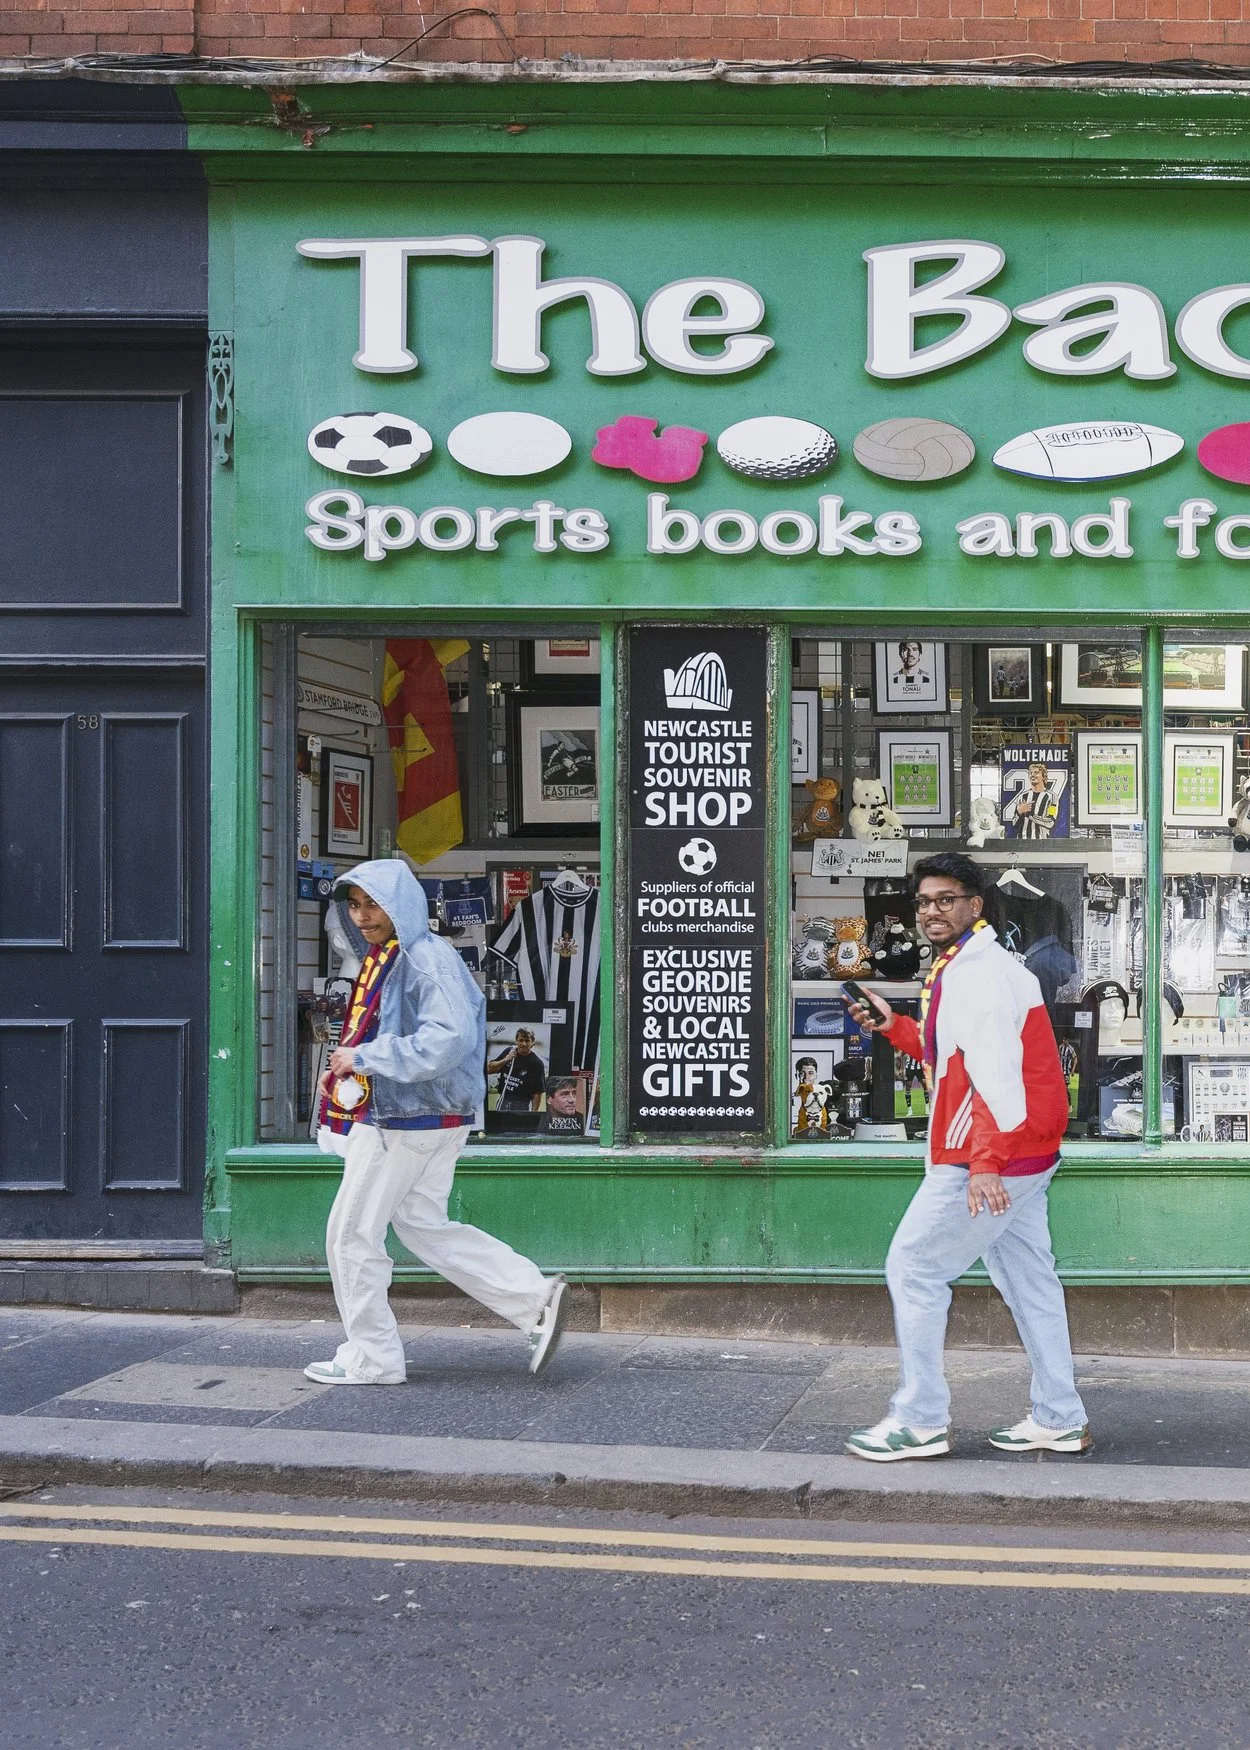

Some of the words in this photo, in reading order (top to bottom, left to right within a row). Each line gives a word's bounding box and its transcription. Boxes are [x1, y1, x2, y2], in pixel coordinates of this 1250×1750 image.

[296, 234, 775, 375] The
[304, 489, 609, 561] Sports
[646, 492, 923, 557] books
[956, 497, 1134, 558] and
[304, 690, 342, 708] STAMFORD
[343, 700, 369, 717] BRIDGE
[77, 714, 99, 730] 58
[644, 720, 752, 737] NEWCASTLE
[644, 742, 752, 764] TOURIST
[1003, 749, 1069, 762] WOLTEMADE
[643, 768, 752, 787] SOUVENIR
[545, 786, 579, 796] EASTER
[1003, 769, 1068, 822] 27
[644, 791, 753, 826] SHOP
[867, 850, 885, 858] NE1
[641, 881, 697, 895] Suppliers
[700, 881, 712, 893] of
[715, 881, 754, 893] official
[637, 898, 756, 917] FOOTBALL
[451, 919, 482, 927] BEDROOM
[641, 921, 673, 933] clubs
[676, 921, 754, 933] merchandise
[643, 950, 752, 968] EXCLUSIVE
[643, 970, 752, 993] GEORDIE
[643, 996, 751, 1013] SOUVENIRS
[643, 1017, 662, 1039] &
[668, 1017, 749, 1039] LOCAL
[642, 1043, 750, 1059] NEWCASTLE
[642, 1063, 750, 1098] GIFTS
